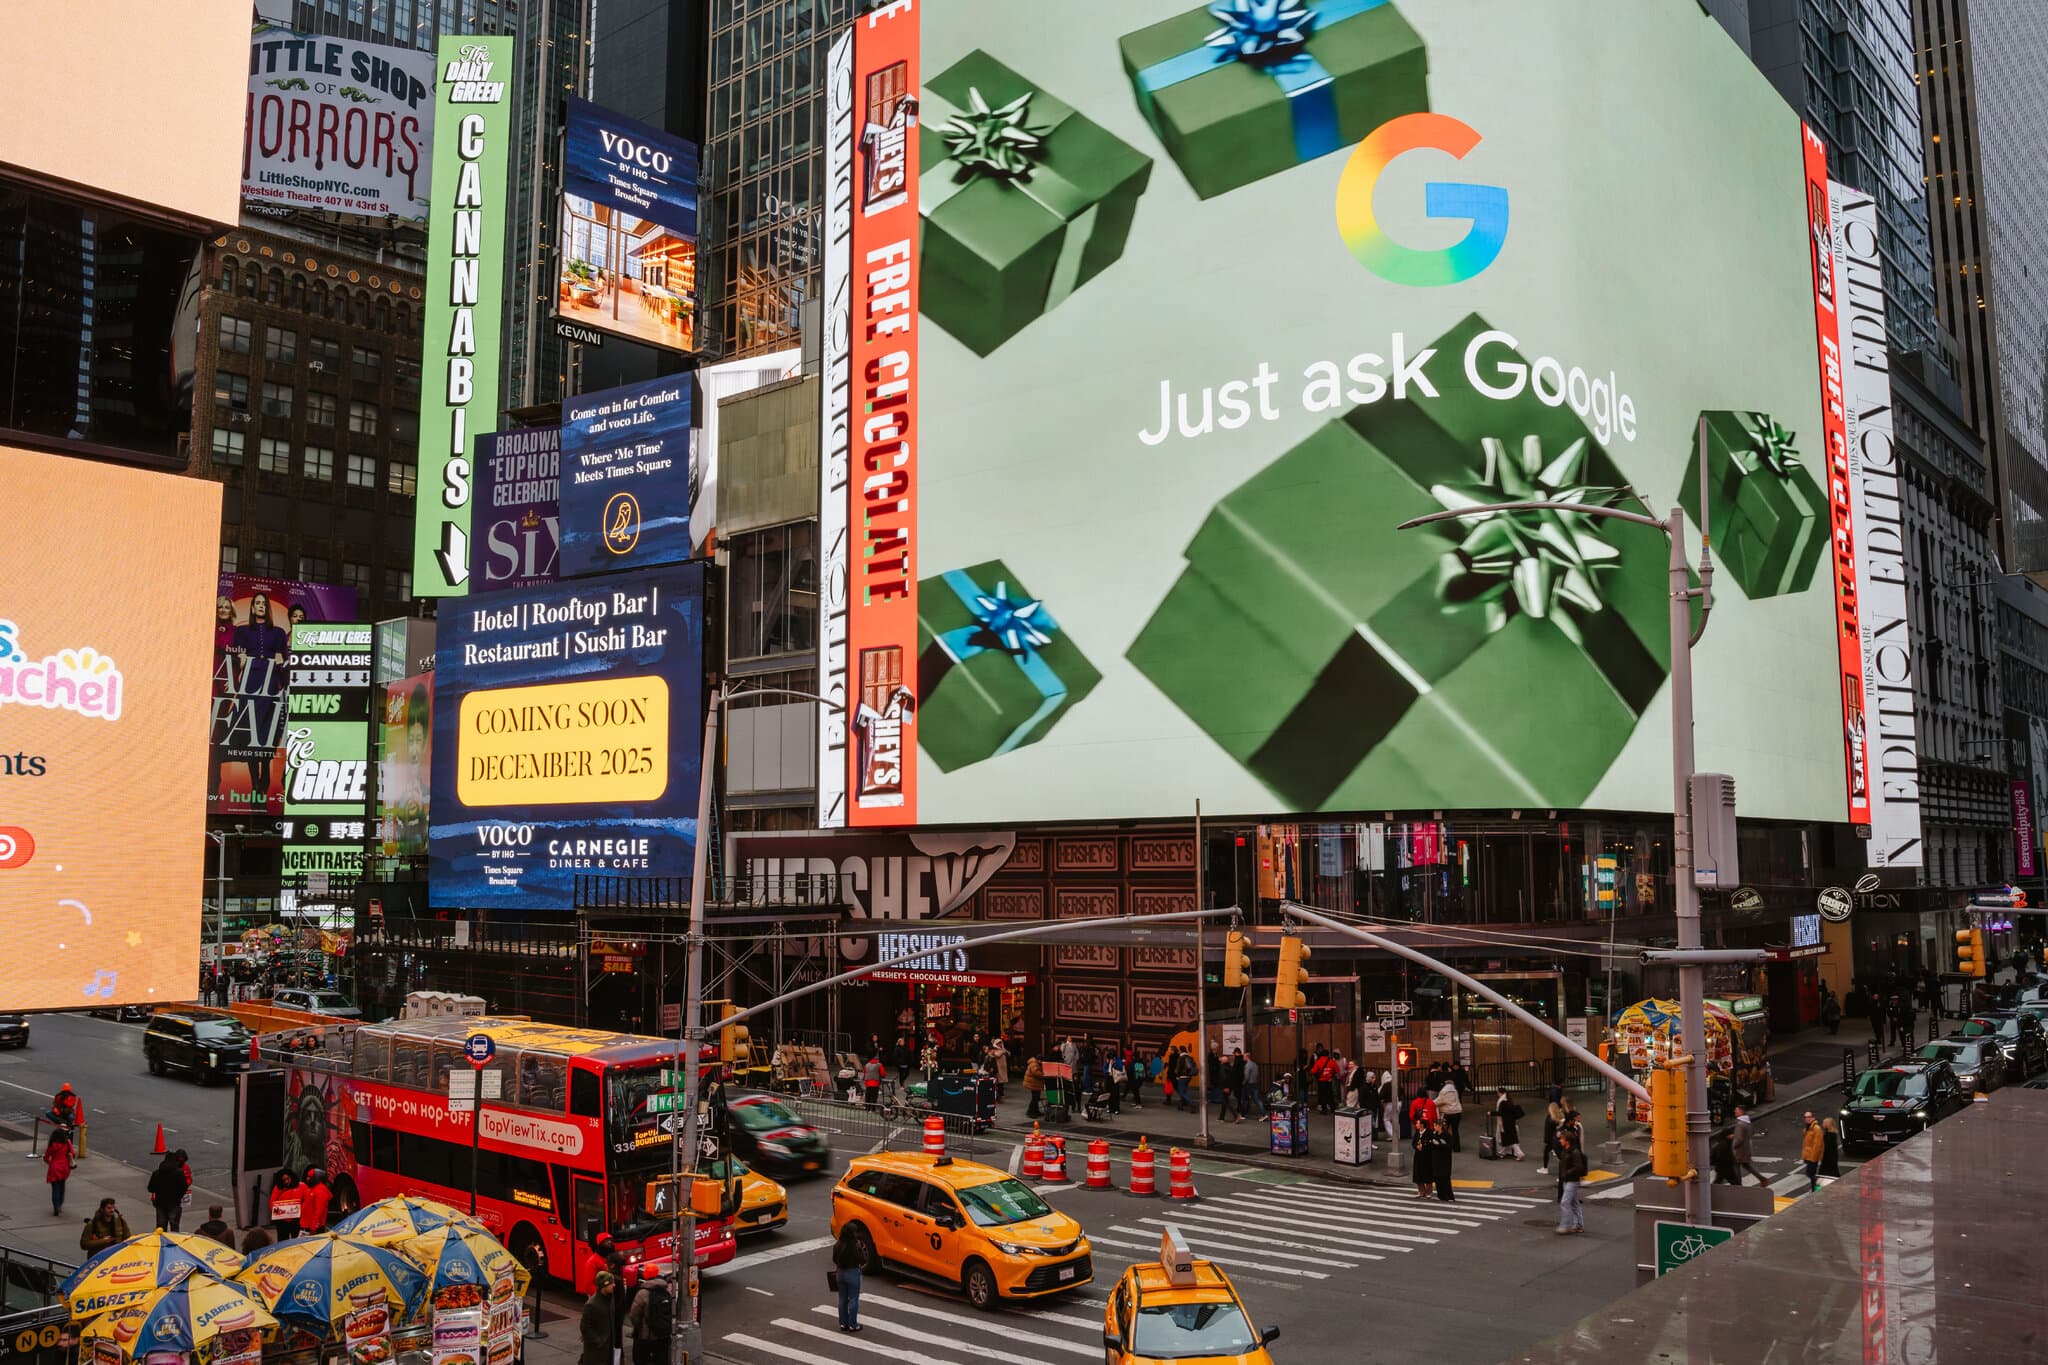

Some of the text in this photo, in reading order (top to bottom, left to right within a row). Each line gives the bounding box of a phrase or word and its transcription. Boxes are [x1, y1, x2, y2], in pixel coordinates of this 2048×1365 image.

[459, 44, 490, 66] The
[351, 51, 426, 110] SHOP
[443, 62, 493, 82] DAILY
[314, 82, 336, 95] OF
[449, 82, 504, 103] GREEN
[833, 28, 851, 246] EDITION
[599, 129, 671, 174] VOCO
[259, 171, 380, 198] LittleShopNYC.com
[619, 162, 648, 181] BY IHG
[241, 184, 284, 199] Westside
[287, 190, 322, 204] Theatre
[343, 197, 353, 206] W
[355, 198, 377, 212] 43rd
[379, 203, 389, 213] St
[608, 174, 658, 200] Times Square
[615, 189, 651, 209] Broadway
[1830, 197, 1844, 265] TIMES SQUARE
[866, 238, 911, 345] FREE
[1840, 192, 1889, 375] EDITION
[443, 113, 486, 508] CANNABIS
[557, 323, 600, 345] KEVANI
[831, 273, 850, 493] EDITION
[1139, 329, 1637, 445] Just ask Google
[570, 389, 680, 420] Come on in for Comfort
[589, 411, 656, 433] and voco Life.
[496, 430, 560, 457] BROADWA
[574, 457, 672, 484] Meets Times Square
[581, 452, 613, 466] Where
[493, 479, 560, 507] CELEBRATI
[1856, 396, 1908, 587] EDITION
[473, 592, 648, 632] Hotel Rooftop Bar
[225, 644, 247, 653] hulu
[317, 631, 346, 645] DAILY
[464, 625, 668, 665] Restaurant Sushi Bar
[827, 527, 847, 752] EDITION
[301, 655, 370, 666] CANNABIS
[1861, 625, 1874, 698] TIMES SQUARE
[288, 694, 341, 714] NEWS
[476, 697, 648, 735] COMING SOON
[1872, 612, 1920, 807] EDITION
[254, 751, 280, 759] SETTLE
[471, 747, 653, 781] DECEMBER 2025
[230, 790, 267, 803] hulu
[477, 825, 532, 846] VOCO
[549, 839, 649, 855] CARNEGIE
[491, 850, 515, 858] BY IHG
[550, 859, 649, 868] DINER & CAFE
[483, 866, 523, 875] Times Square
[489, 877, 517, 887] Broadway
[603, 962, 633, 971] SALE
[872, 971, 976, 983] HERSHEY'S CHOCOLATE WORLD
[354, 1091, 372, 1106] GET
[483, 1114, 577, 1148] TopViewTix.com
[615, 1141, 636, 1153] 336
[336, 1272, 379, 1302] SABRETT
[75, 1290, 148, 1314] SABRETT
[197, 1300, 245, 1328] SABRETT
